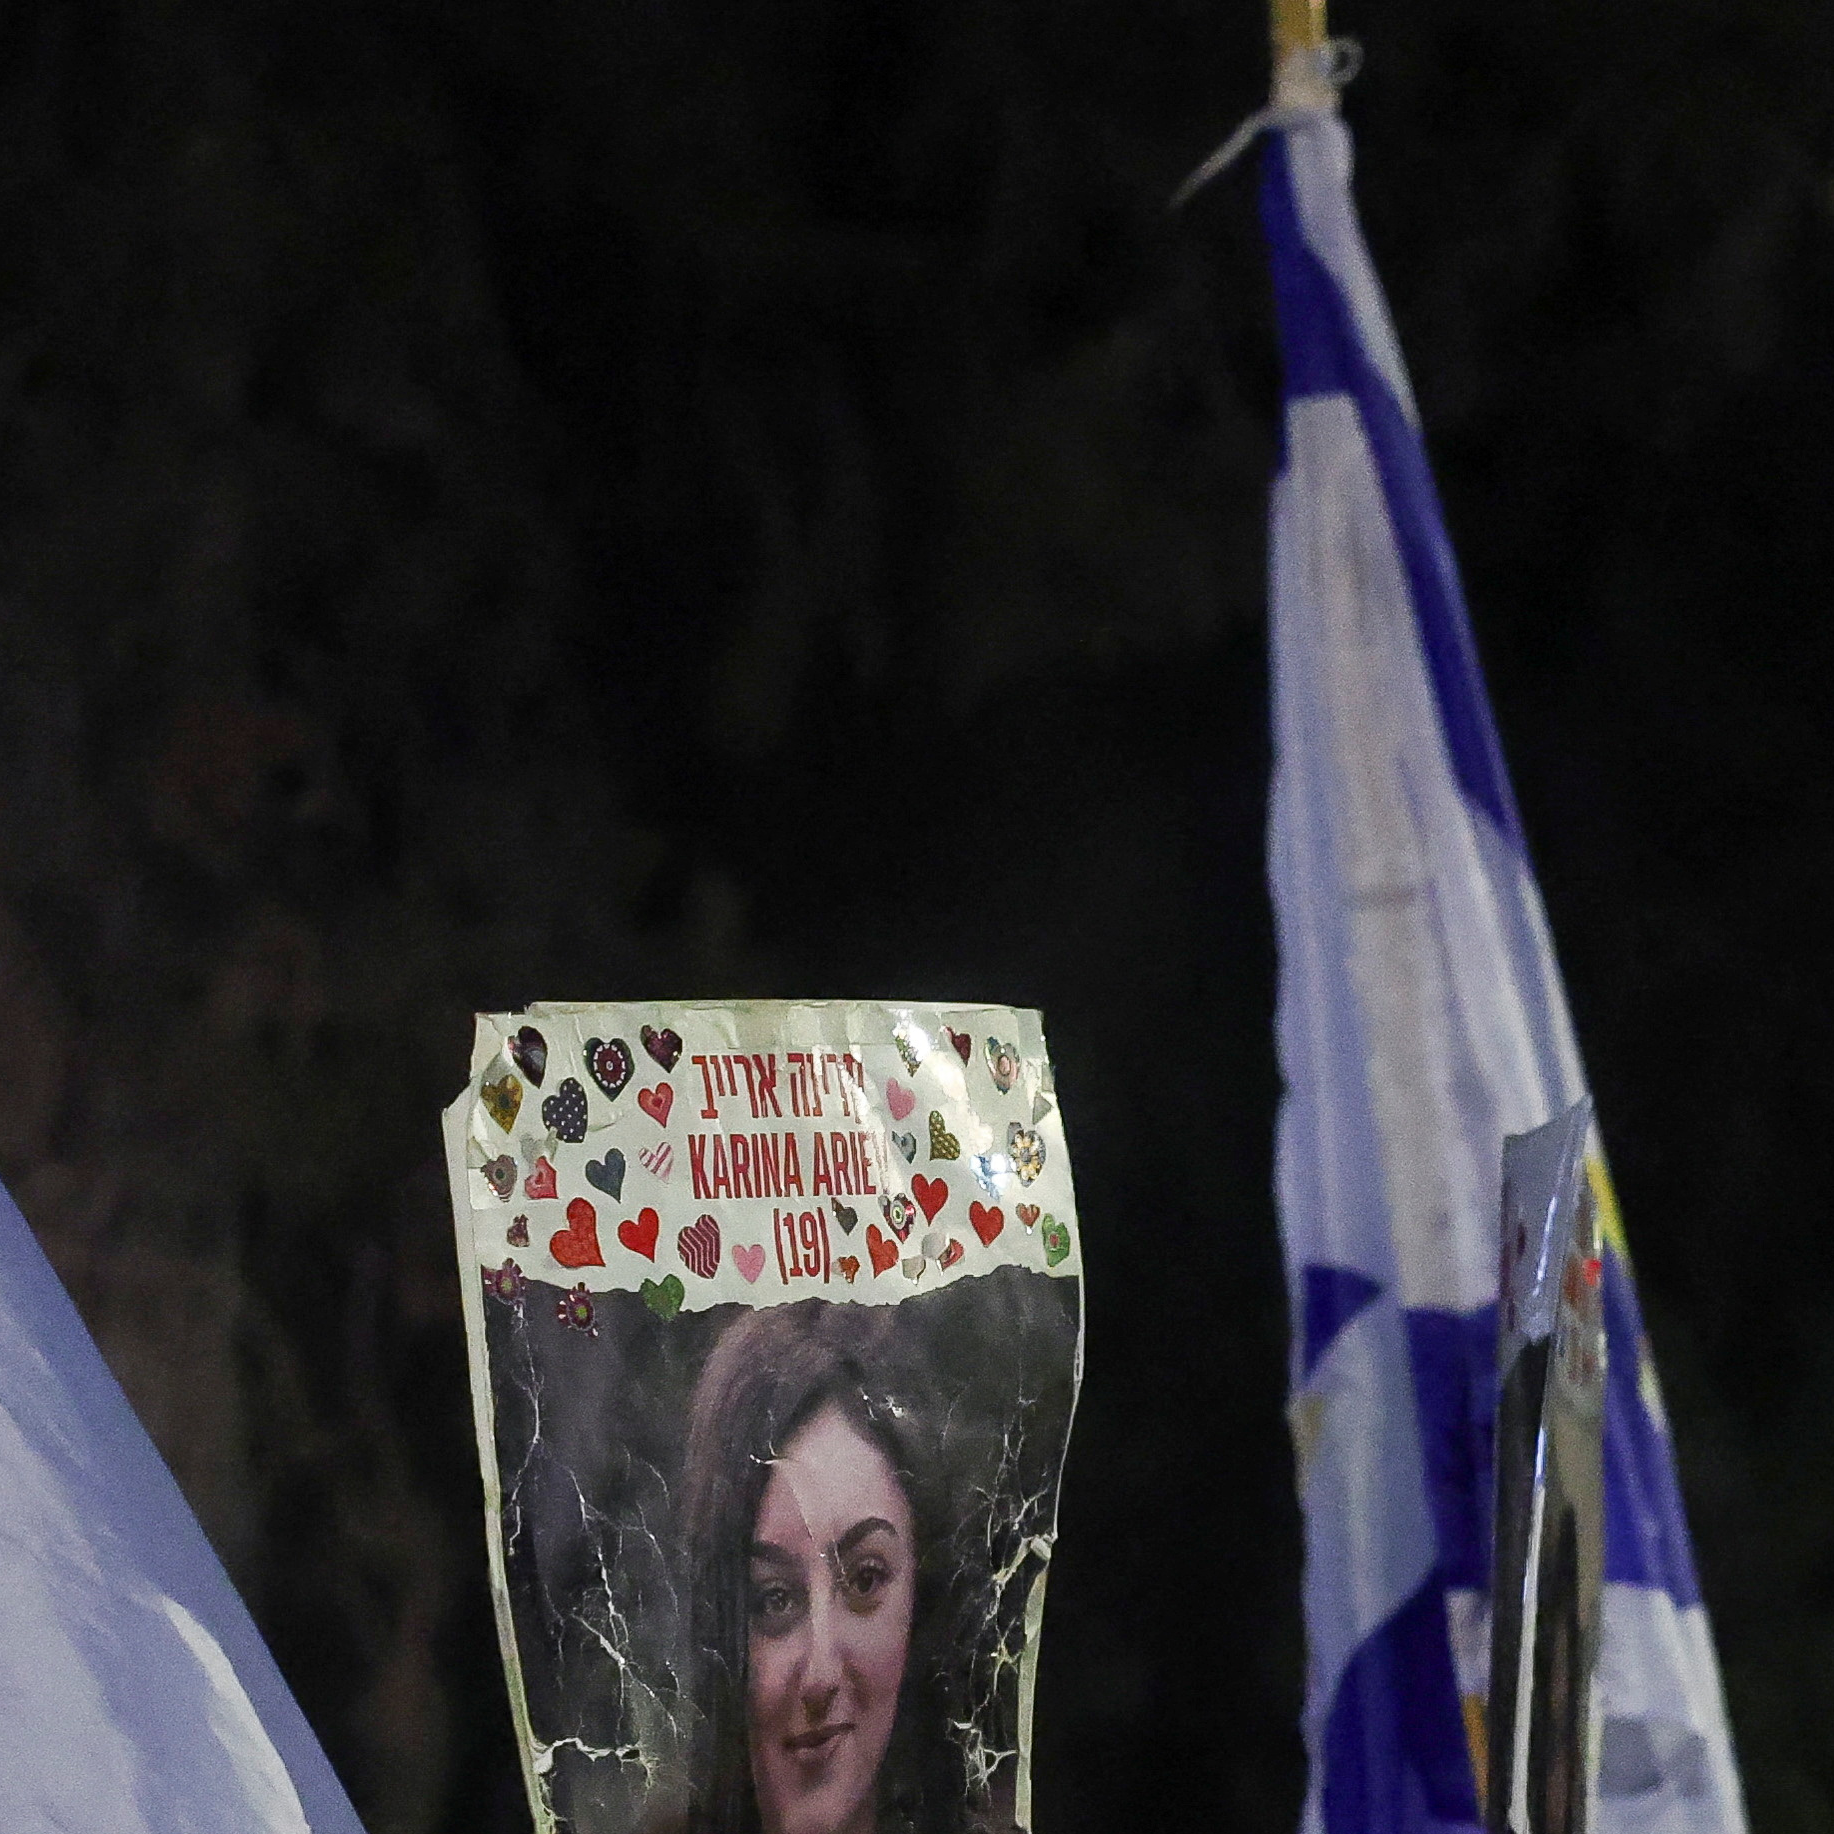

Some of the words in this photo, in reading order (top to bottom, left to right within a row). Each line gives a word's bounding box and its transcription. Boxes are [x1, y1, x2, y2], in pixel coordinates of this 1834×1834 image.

[691, 1053, 783, 1119] ארייב
[688, 1133, 804, 1200] KARINA
[773, 1207, 831, 1286] (19)
